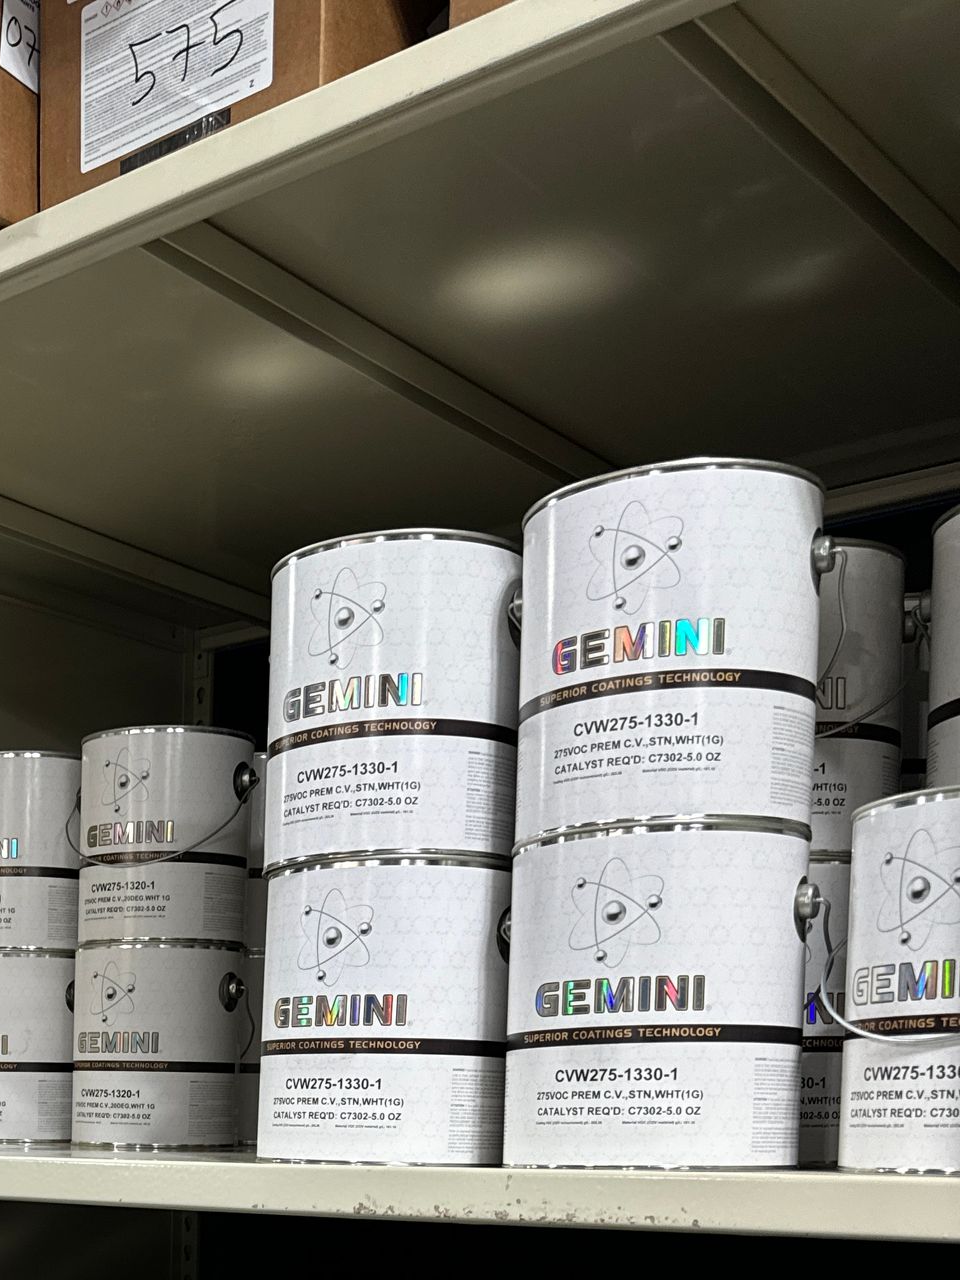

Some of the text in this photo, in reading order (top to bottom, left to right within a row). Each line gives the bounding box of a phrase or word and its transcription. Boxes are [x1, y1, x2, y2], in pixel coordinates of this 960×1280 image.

[129, 0, 244, 106] 575
[552, 617, 726, 676] GEMINI
[282, 672, 423, 723] GEMINI
[540, 671, 741, 706] SUPERIOR COATINGS TECHNOLOGY
[311, 720, 438, 741] COATINGS TECHNOLOGY
[573, 712, 699, 737] CVW275-1330-1
[554, 739, 621, 759] 275VOC PREM
[297, 761, 398, 784] CVW275-1330-1
[554, 758, 604, 775] CATALYST
[607, 754, 645, 768] REQ'D:
[648, 752, 703, 764] C7302-5.0
[705, 752, 721, 763] OZ
[309, 785, 333, 800] PREM
[283, 796, 418, 818] CATALYST C7302-5.0 OZ
[87, 820, 174, 848] GEMINI
[91, 881, 155, 893] CVW275-1320-1
[535, 974, 706, 1018] GEMINI
[274, 994, 408, 1028] GEMINI
[878, 1018, 935, 1031] COATINGS
[77, 1031, 159, 1054] GEMINI
[524, 1027, 721, 1044] SUPERIOR COATINGS TECHNOLOGY
[266, 1040, 421, 1051] SUPERIOR COATINGS TECHNOLOGY
[285, 1078, 382, 1090] CVW275-1330-1
[555, 1068, 678, 1083] CVW275-1330-1
[81, 1089, 140, 1098] CVW275-1320-1
[296, 1097, 319, 1107] PREM
[536, 1090, 601, 1101] 275VOC PREM
[876, 1090, 903, 1100] PREM
[273, 1110, 402, 1121] CATALYST C7302-5.0 OZ
[537, 1106, 701, 1117] CATALYST REQ'D: C7302-5.0 OZ
[851, 1108, 888, 1118] CATALYST
